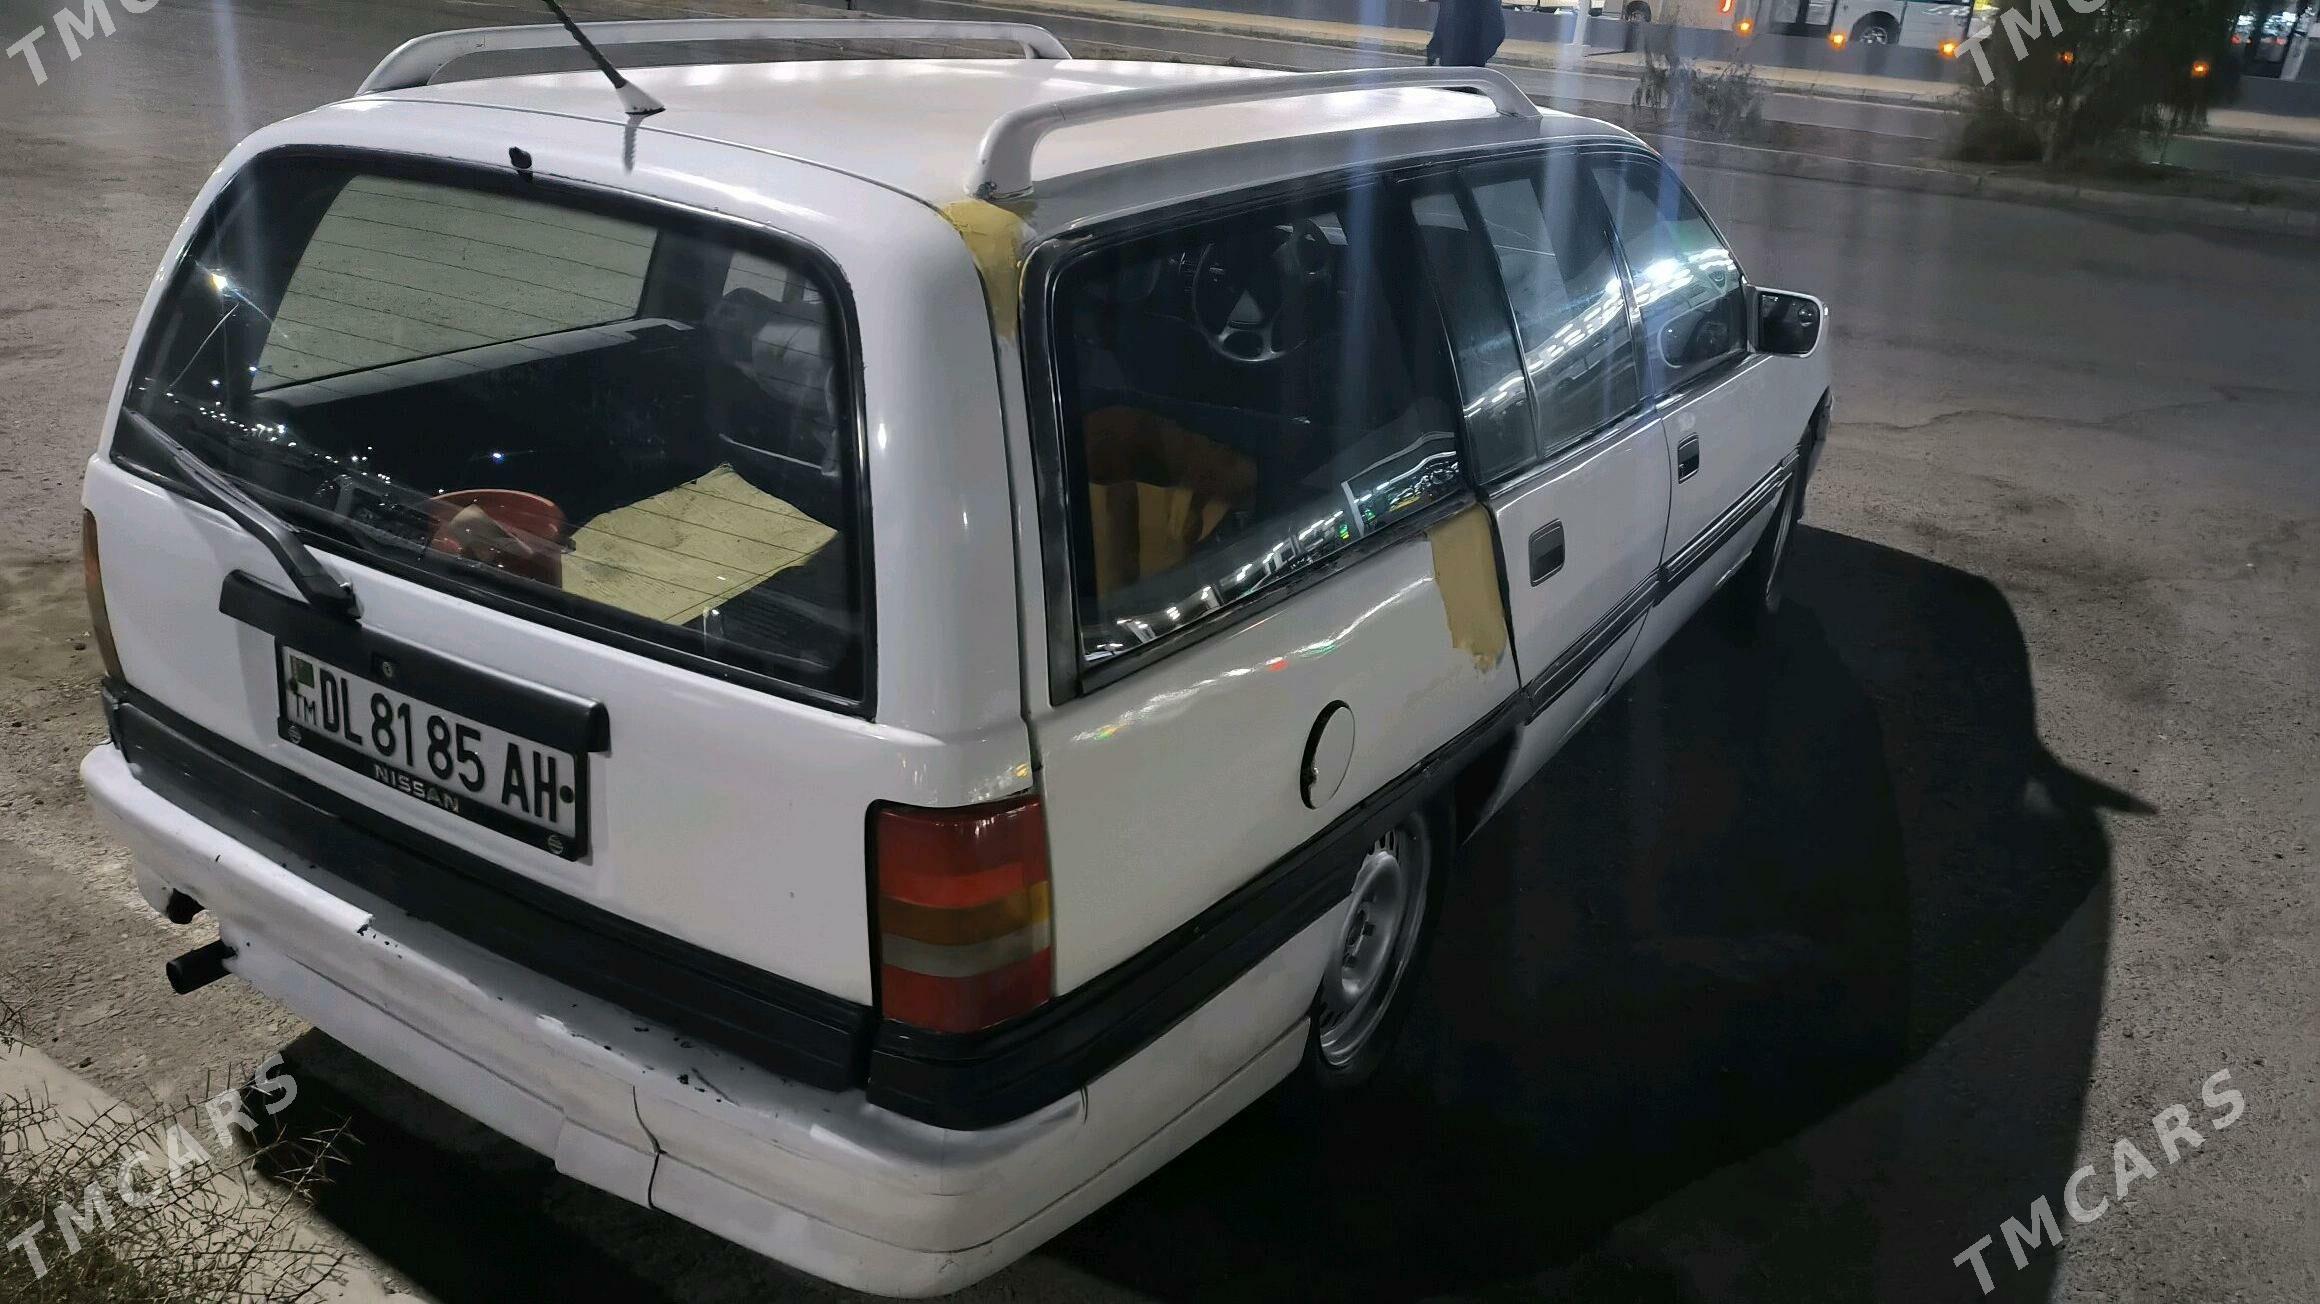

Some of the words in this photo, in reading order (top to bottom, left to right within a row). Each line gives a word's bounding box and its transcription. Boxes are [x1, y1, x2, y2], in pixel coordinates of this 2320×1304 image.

[320, 667, 363, 746] DL
[501, 742, 557, 823] AH
[374, 764, 459, 813] NISSAN
